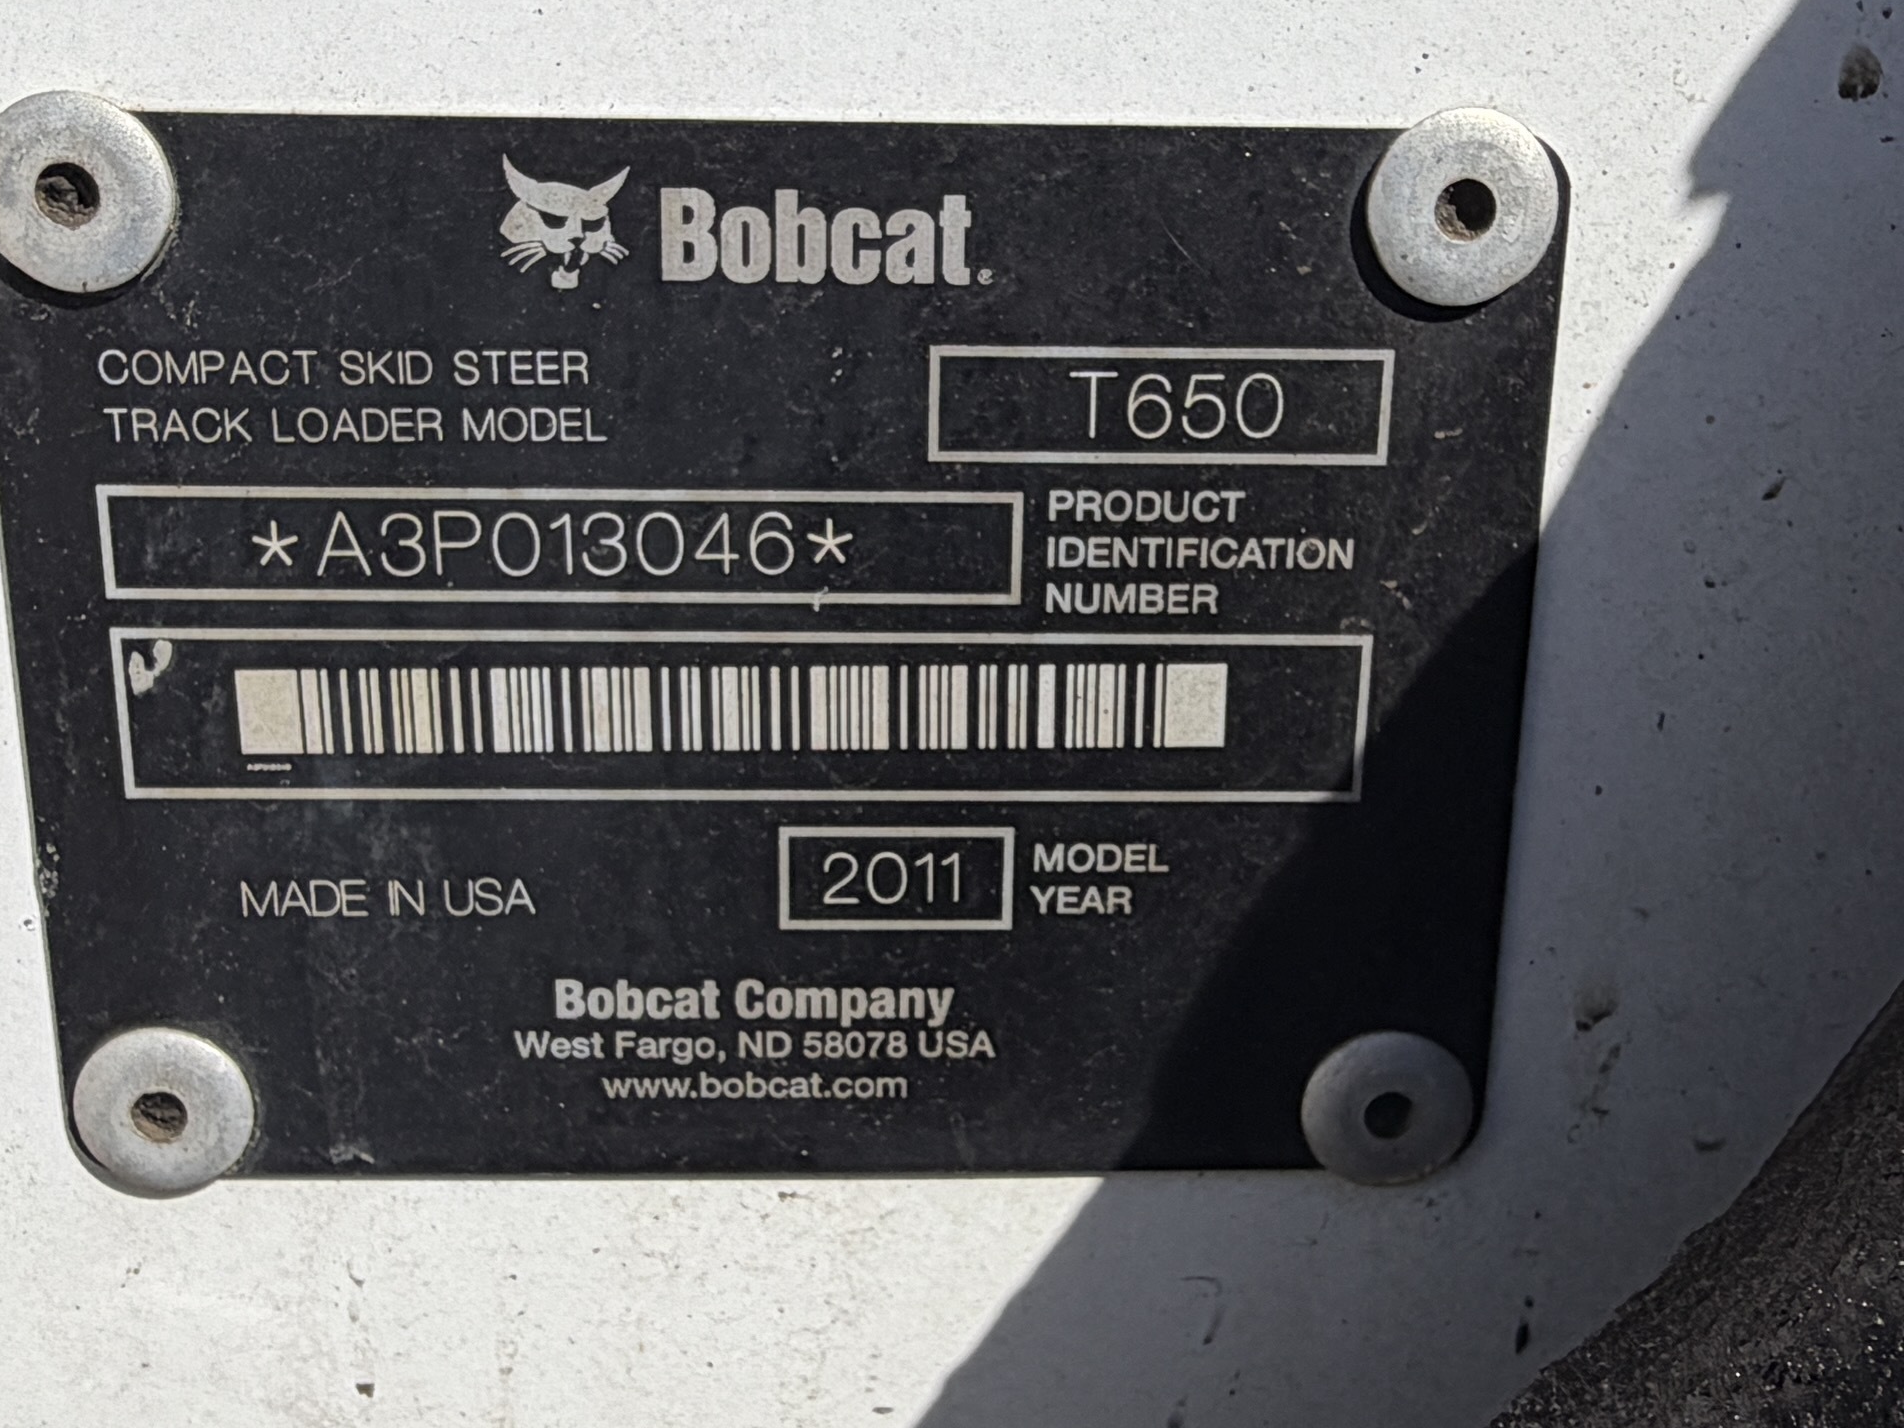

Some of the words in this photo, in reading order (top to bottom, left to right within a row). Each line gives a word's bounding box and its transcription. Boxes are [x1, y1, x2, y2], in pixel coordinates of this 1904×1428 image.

[661, 188, 971, 286] Bobcat
[98, 349, 317, 385] COMPACT
[340, 350, 432, 385] SKID
[454, 350, 588, 385] STEER
[1070, 371, 1283, 439] T650
[103, 408, 252, 443] TRACK
[272, 408, 443, 442] LOADER
[463, 408, 607, 442] MODEL
[1049, 490, 1245, 522] PRODUCT
[1047, 536, 1354, 569] IDENTIFICATION
[1046, 583, 1218, 614] NUMBER
[1034, 843, 1168, 872] MODEL
[823, 852, 959, 904] 2011
[241, 880, 368, 917] MADE
[388, 880, 424, 915] IN
[444, 878, 535, 916] USA
[1030, 886, 1131, 914] YEAR
[554, 978, 721, 1020] Bobcat
[735, 979, 954, 1027] Company
[513, 1030, 605, 1059] West
[615, 1030, 727, 1066] Fargo,
[739, 1031, 792, 1058] ND
[803, 1031, 907, 1058] 58078
[919, 1031, 995, 1058] USA
[602, 1071, 907, 1098] www.bobcat.com
